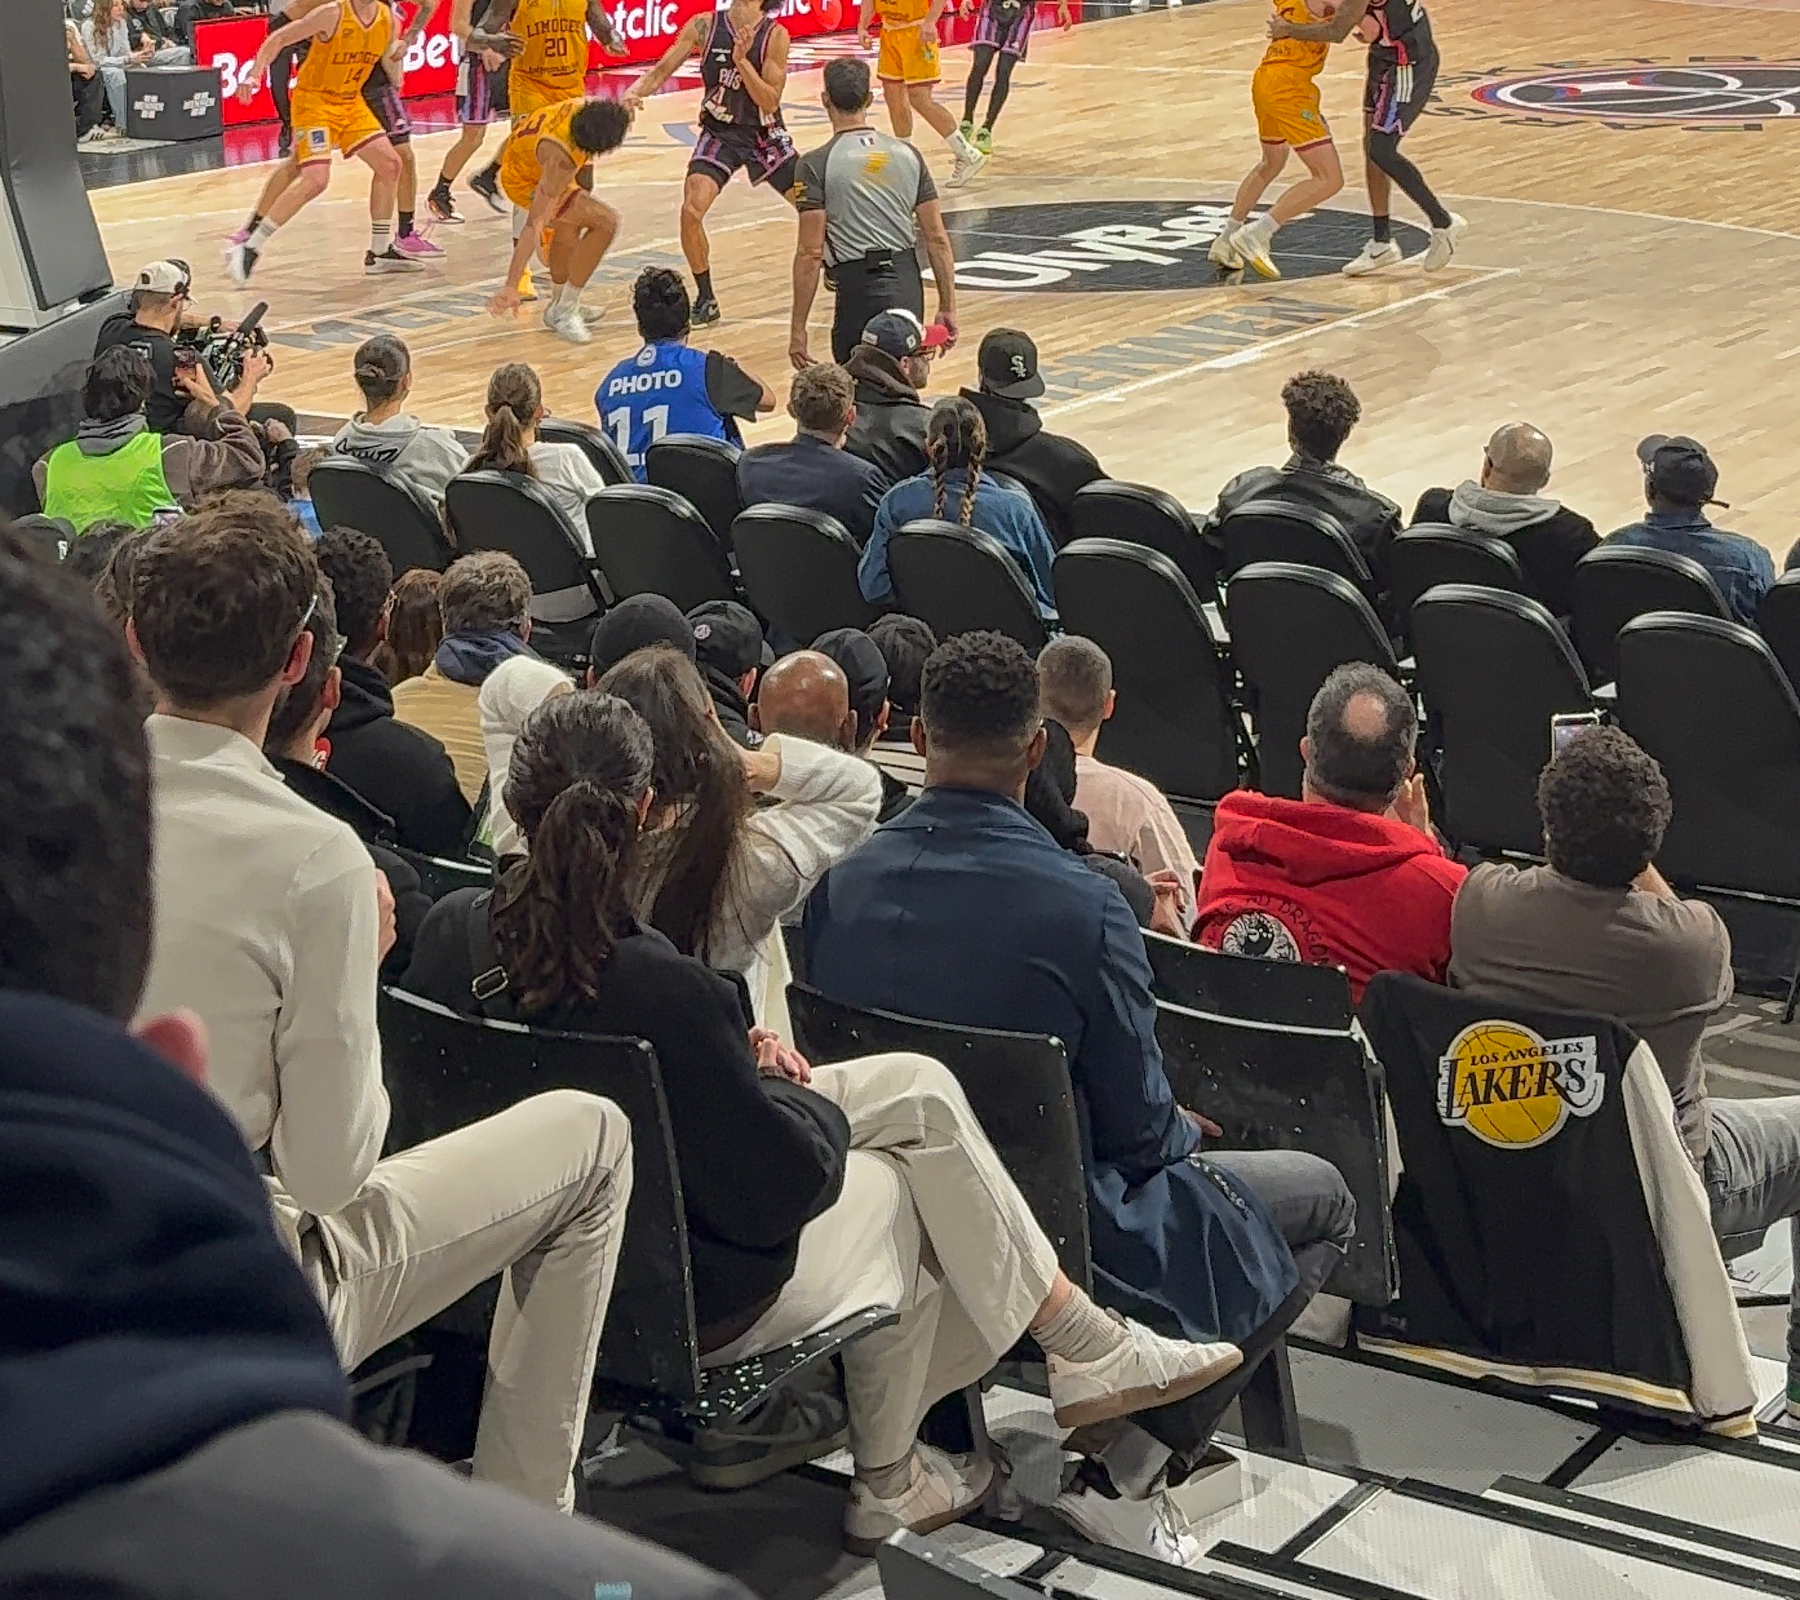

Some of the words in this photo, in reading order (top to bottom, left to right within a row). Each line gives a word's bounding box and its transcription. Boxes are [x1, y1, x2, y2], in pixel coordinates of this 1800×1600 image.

[544, 37, 568, 58] 20
[609, 369, 683, 398] PHOTO
[606, 404, 670, 461] 11
[1470, 1051, 1500, 1067] LOS
[1502, 1041, 1584, 1063] ANGELES
[1442, 1057, 1598, 1119] LAKERS
